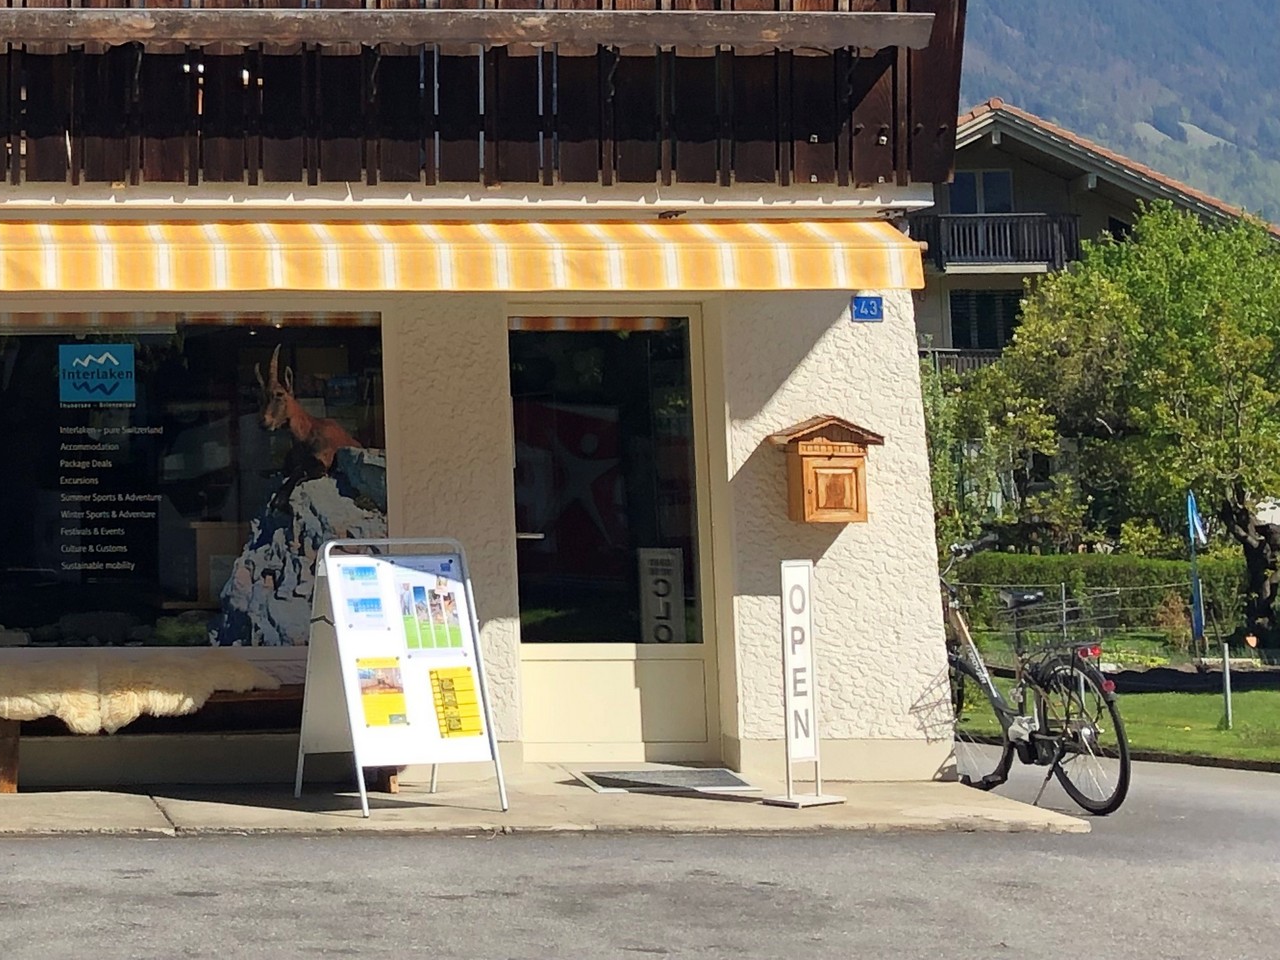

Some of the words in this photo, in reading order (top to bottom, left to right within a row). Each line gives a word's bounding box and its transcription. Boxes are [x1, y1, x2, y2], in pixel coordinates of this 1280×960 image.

[860, 300, 878, 316] 43
[62, 368, 133, 380] interlaken
[60, 426, 96, 435] Interlaken
[103, 427, 120, 436] pure
[121, 426, 164, 435] Switzerland
[60, 442, 120, 451] Accommodation
[60, 459, 90, 469] Package
[91, 459, 113, 468] Deals
[60, 476, 99, 485] Excursions
[60, 493, 91, 502] Summer
[92, 493, 116, 502] Sports
[117, 493, 124, 501] &
[125, 493, 163, 502] Adventure
[60, 510, 84, 518] Winter
[85, 510, 110, 520] Sports
[111, 510, 117, 518] &
[119, 510, 156, 518] Adventure
[60, 527, 92, 536] Festivals
[93, 527, 100, 535] &
[100, 527, 125, 535] Events
[60, 544, 87, 553] Culture
[88, 544, 95, 552] &
[96, 544, 128, 552] Customs
[61, 561, 104, 570] Sustainable
[105, 561, 136, 571] mobility
[788, 584, 810, 739] OPEN
